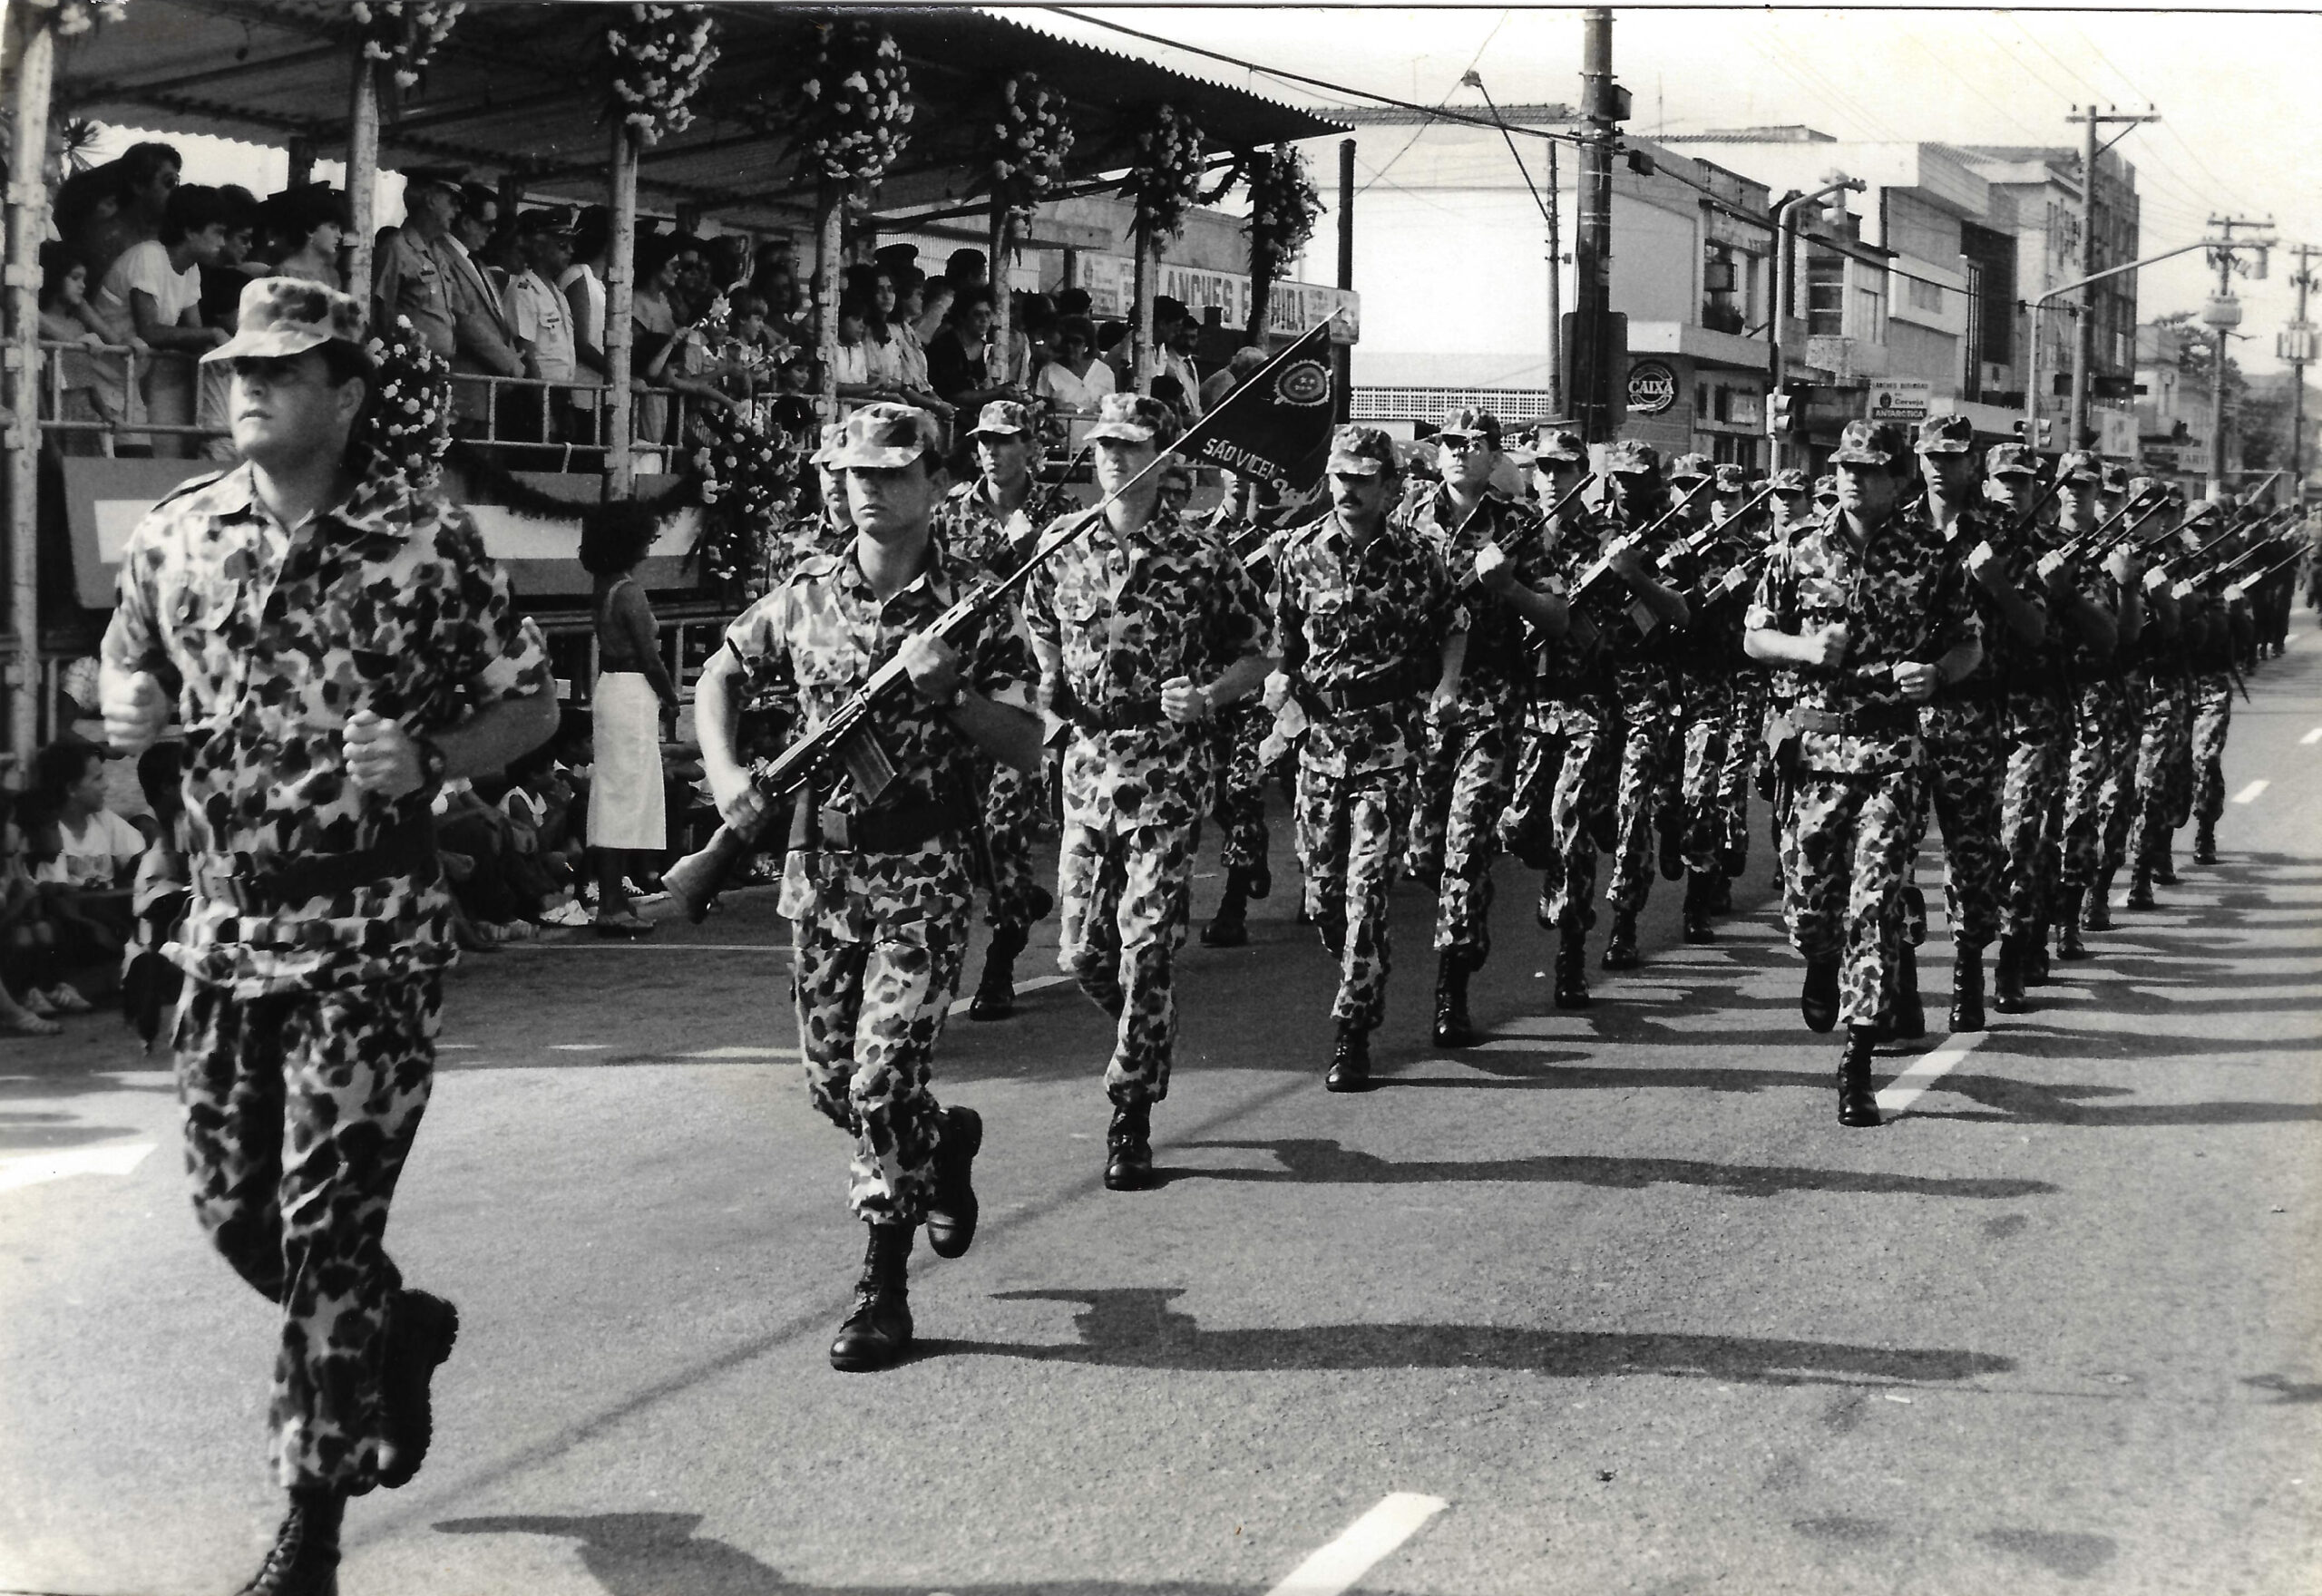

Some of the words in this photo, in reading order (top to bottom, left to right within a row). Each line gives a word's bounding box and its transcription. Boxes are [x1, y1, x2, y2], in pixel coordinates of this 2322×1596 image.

[1166, 271, 1234, 323] ANCHES
[1628, 380, 1674, 394] CAIXA
[1895, 398, 1924, 407] Cerveja
[1203, 438, 1237, 462] SÃO
